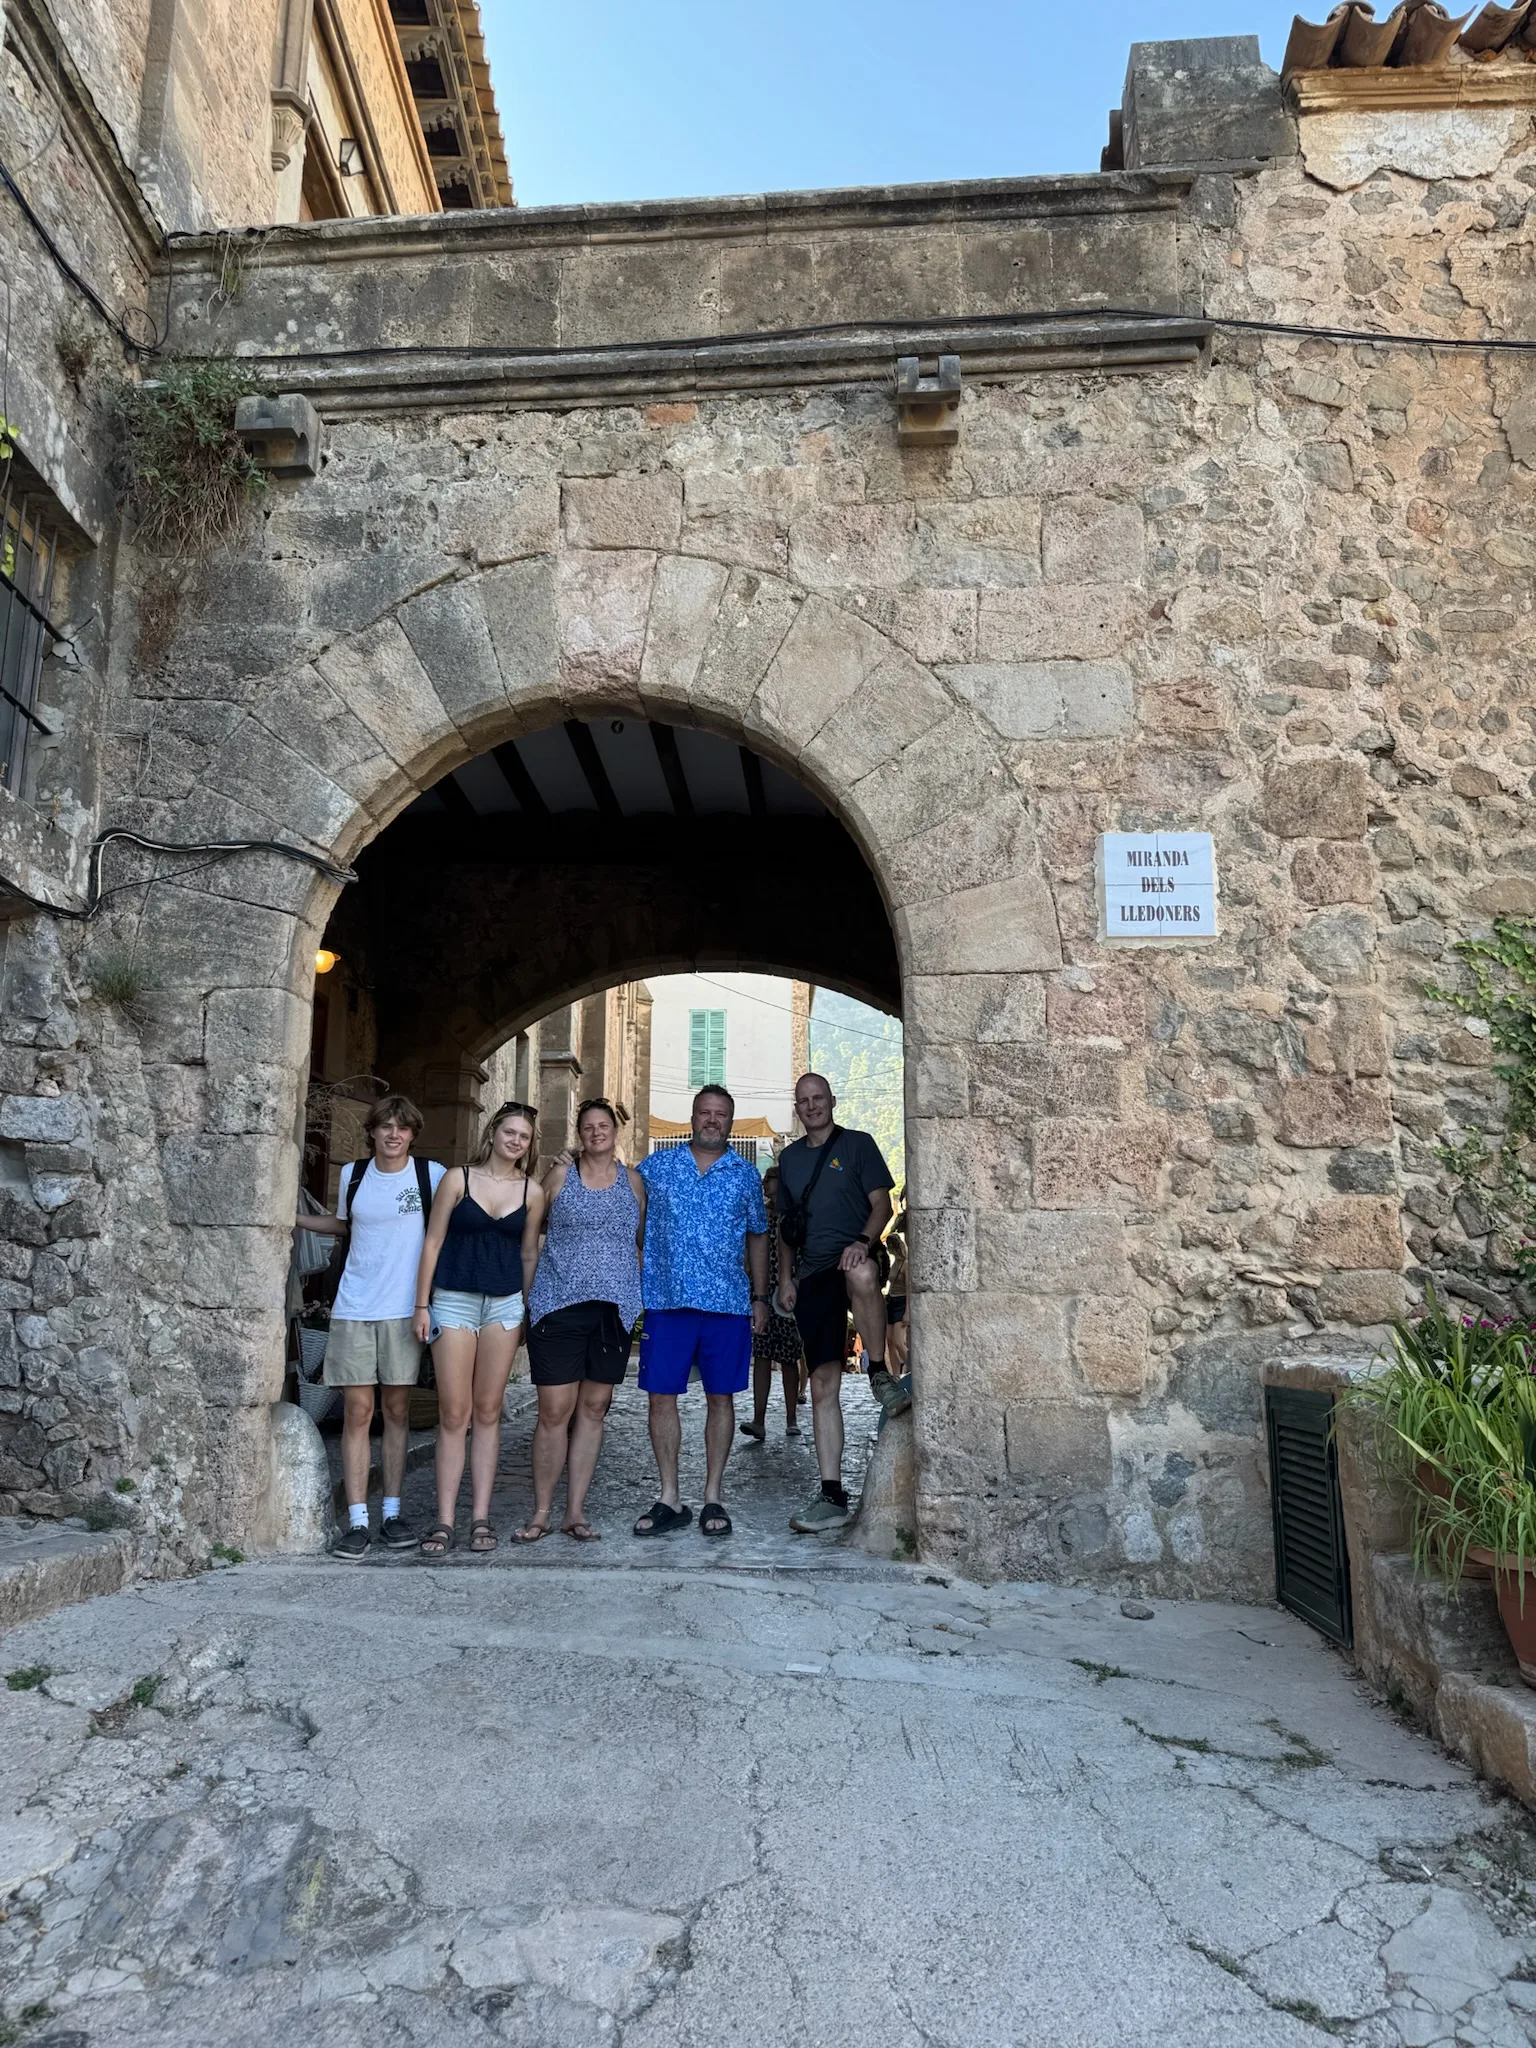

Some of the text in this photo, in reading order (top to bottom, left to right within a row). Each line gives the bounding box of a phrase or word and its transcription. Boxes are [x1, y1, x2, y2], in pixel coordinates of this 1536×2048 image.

[1127, 850, 1189, 867] MIRANDA
[1141, 876, 1175, 893] DELS
[1121, 905, 1200, 922] LLEDONERS
